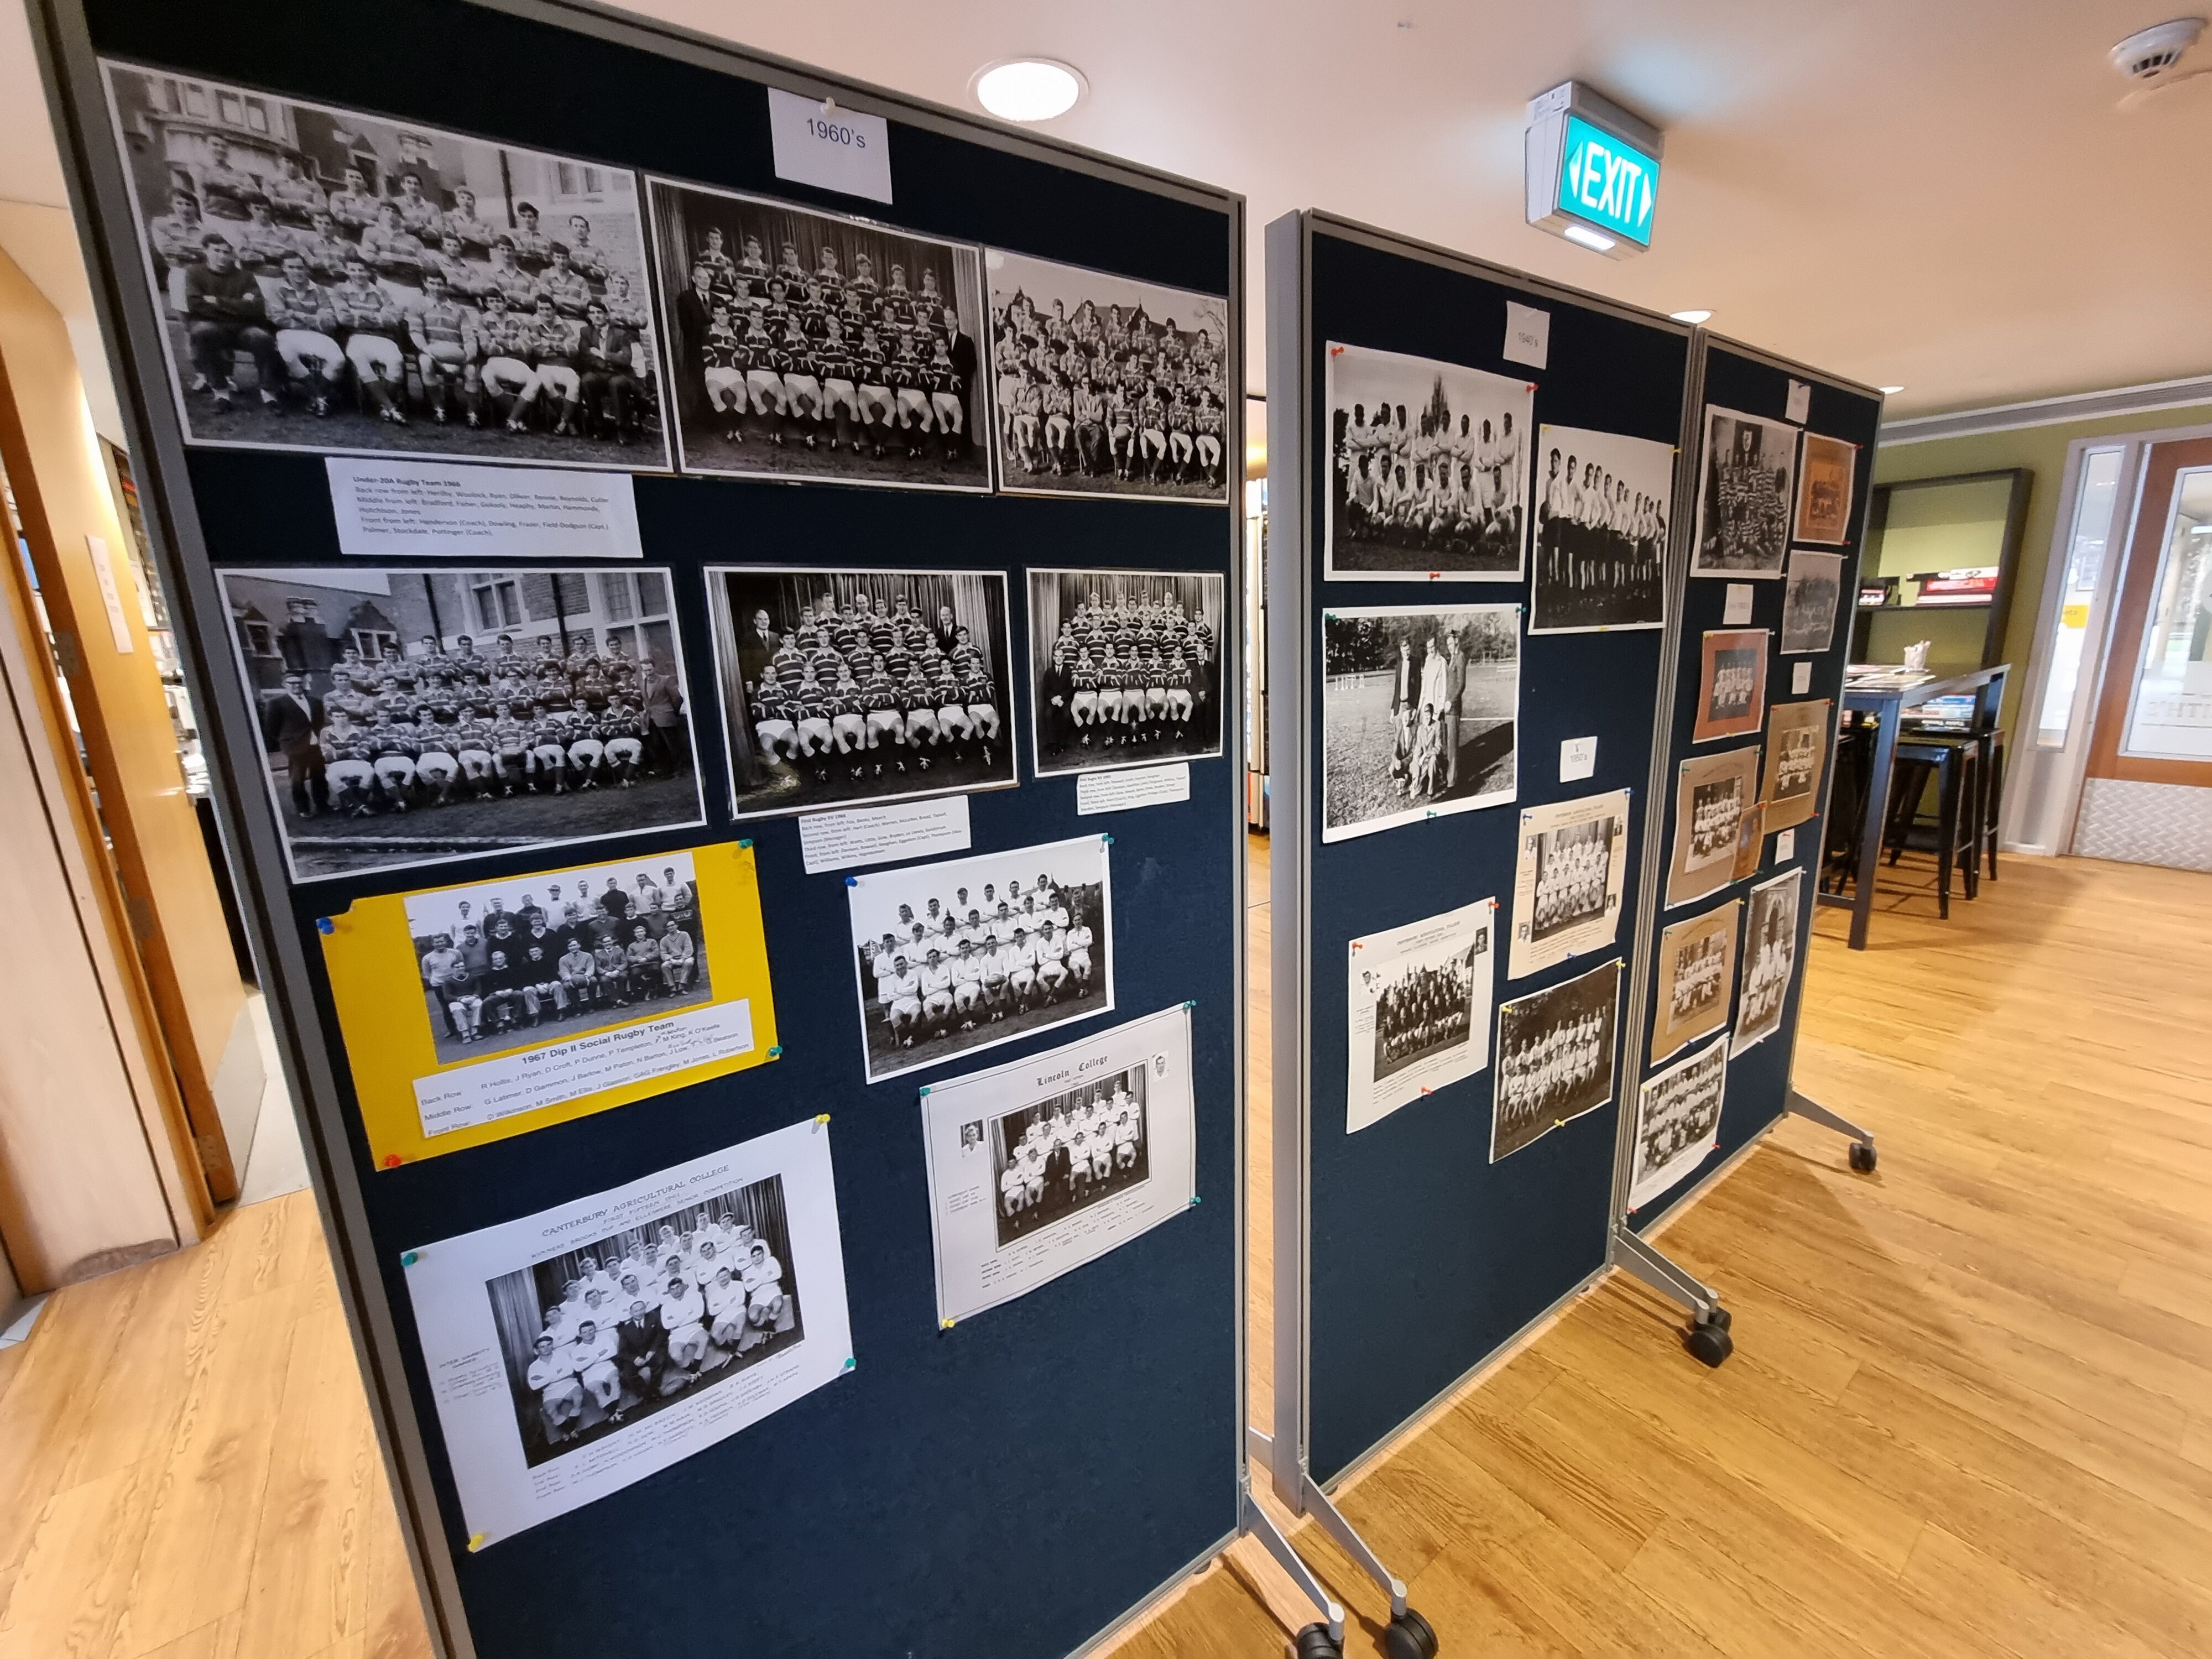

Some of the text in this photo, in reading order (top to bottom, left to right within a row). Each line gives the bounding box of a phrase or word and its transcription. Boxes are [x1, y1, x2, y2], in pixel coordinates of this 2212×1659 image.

[806, 118, 866, 148] 1960's
[1581, 141, 1642, 223] EXIT
[522, 1052, 546, 1065] 1967
[549, 1048, 568, 1057] Dip
[579, 1036, 611, 1050] Social
[613, 1029, 645, 1041] Rugby
[647, 1022, 674, 1032] Team
[1037, 1070, 1070, 1086] Lincoln
[1079, 1056, 1108, 1071] College
[420, 1096, 442, 1106] Back
[424, 1110, 452, 1120] Middle
[541, 1165, 729, 1237] CANTERBURY AGRICULTURAL COLLEGE
